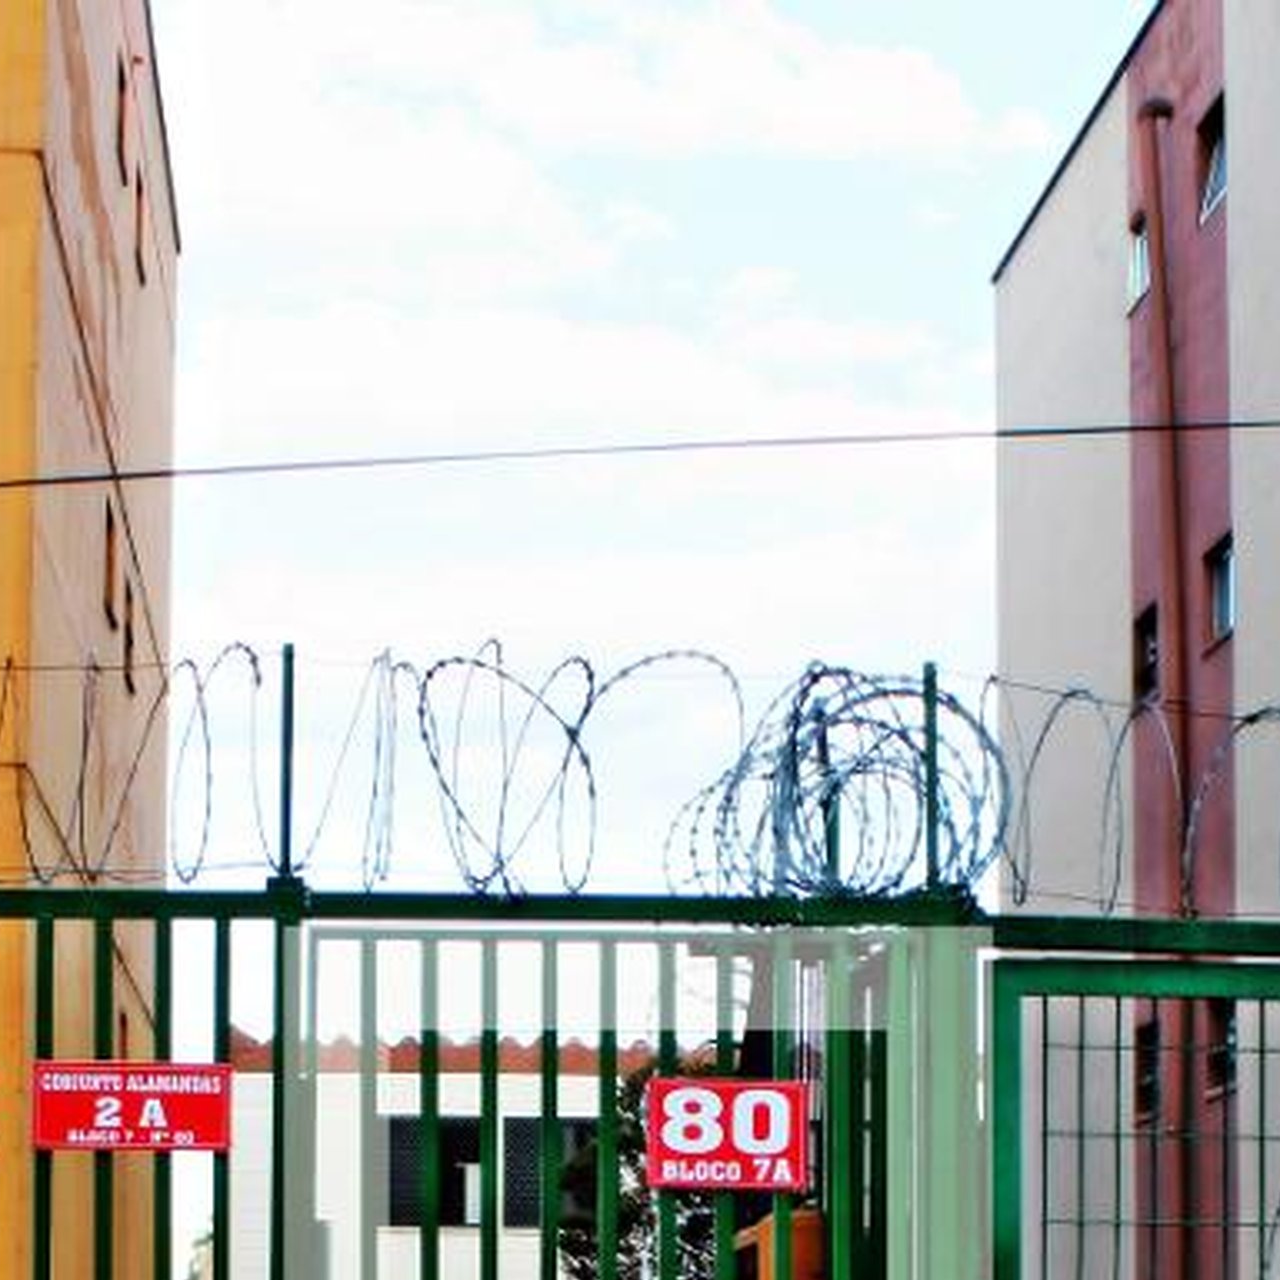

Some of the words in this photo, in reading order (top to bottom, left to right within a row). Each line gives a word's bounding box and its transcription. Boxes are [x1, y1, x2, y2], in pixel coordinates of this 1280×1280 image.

[94, 1096, 122, 1128] 2
[138, 1097, 168, 1128] A
[660, 1087, 792, 1156] 80
[661, 1159, 742, 1182] BLOCO
[752, 1159, 792, 1183] 7A
